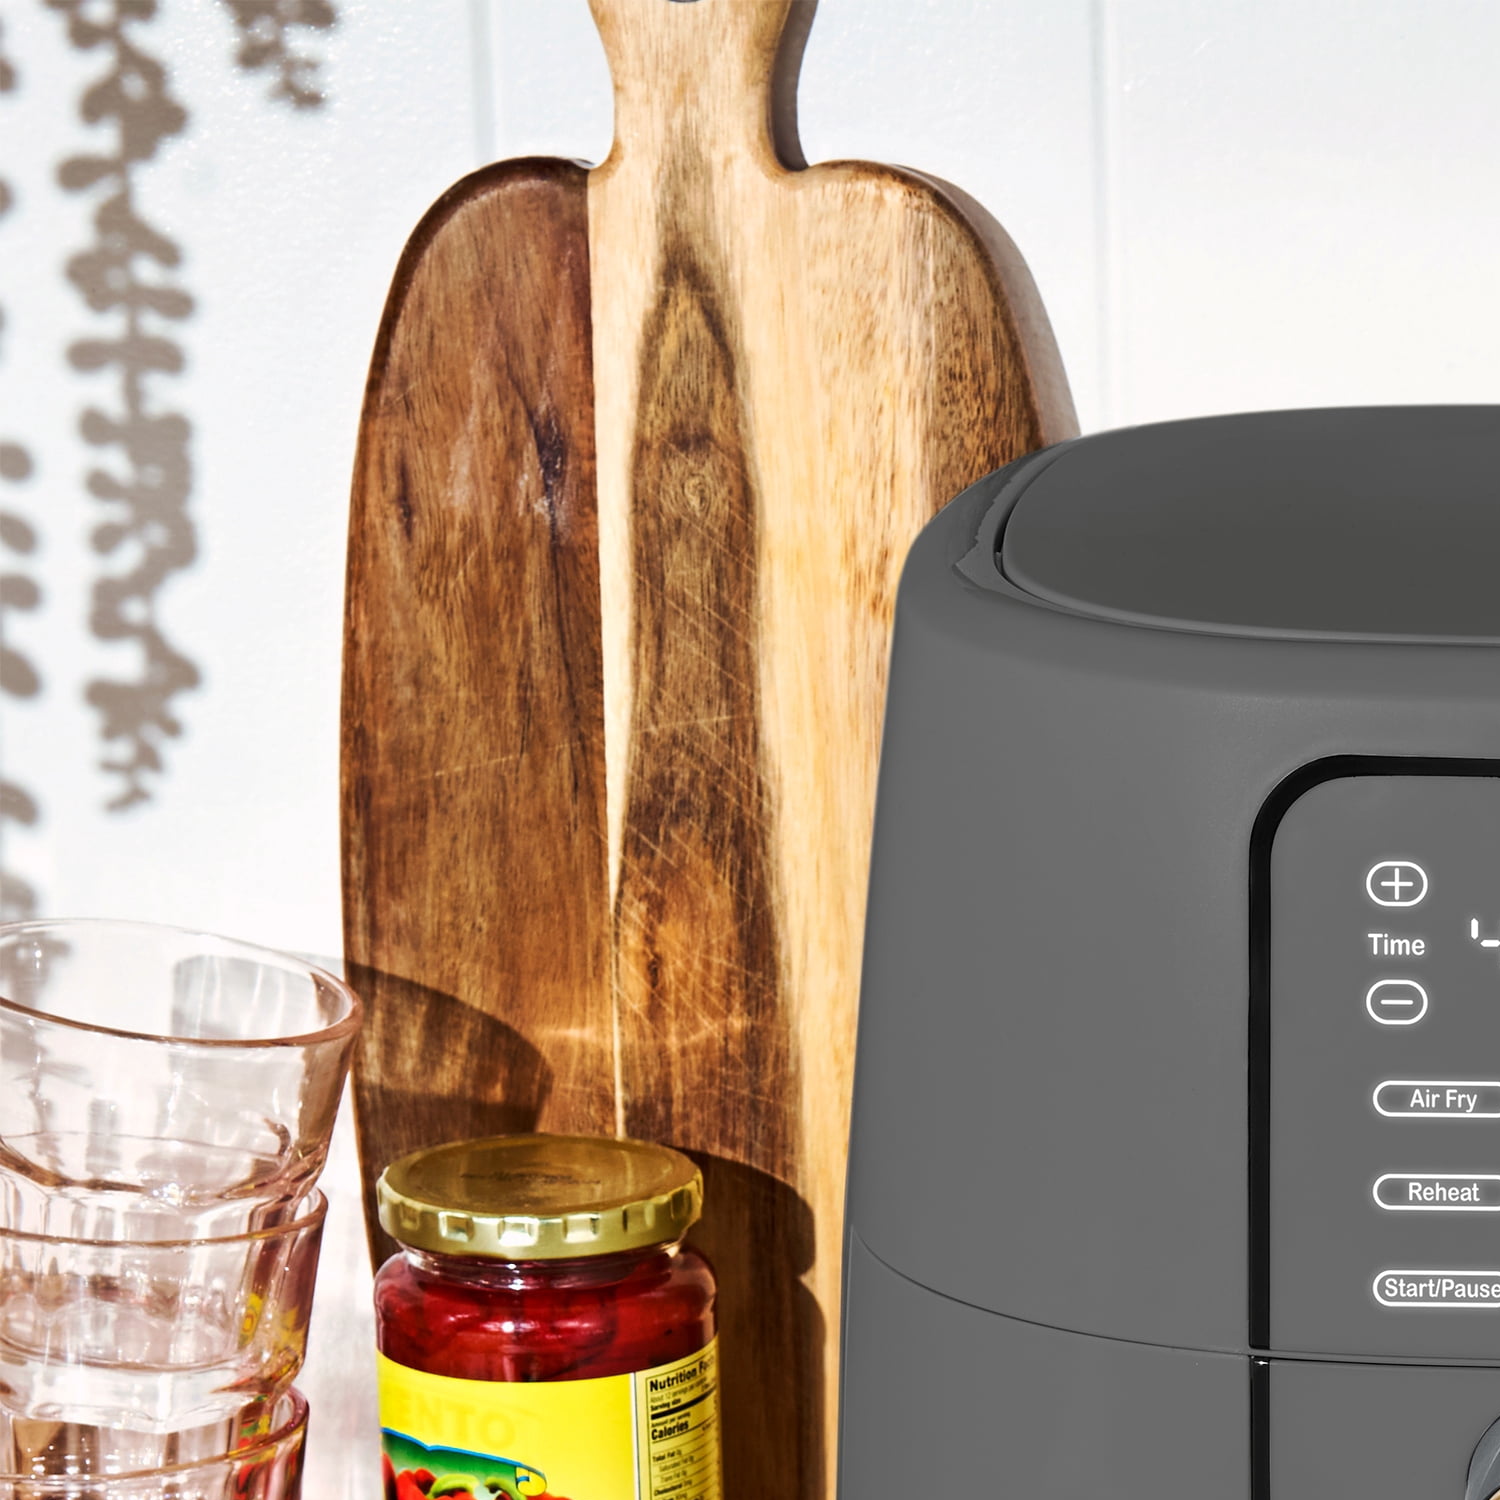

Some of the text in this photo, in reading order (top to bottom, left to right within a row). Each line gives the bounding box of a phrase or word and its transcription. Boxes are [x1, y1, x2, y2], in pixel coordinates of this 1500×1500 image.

[1368, 933, 1425, 955] Time
[1410, 1089, 1477, 1112] Air Fry
[1409, 1182, 1480, 1201] Reheat
[650, 1368, 697, 1392] Nutrition
[651, 1420, 689, 1441] Calories
